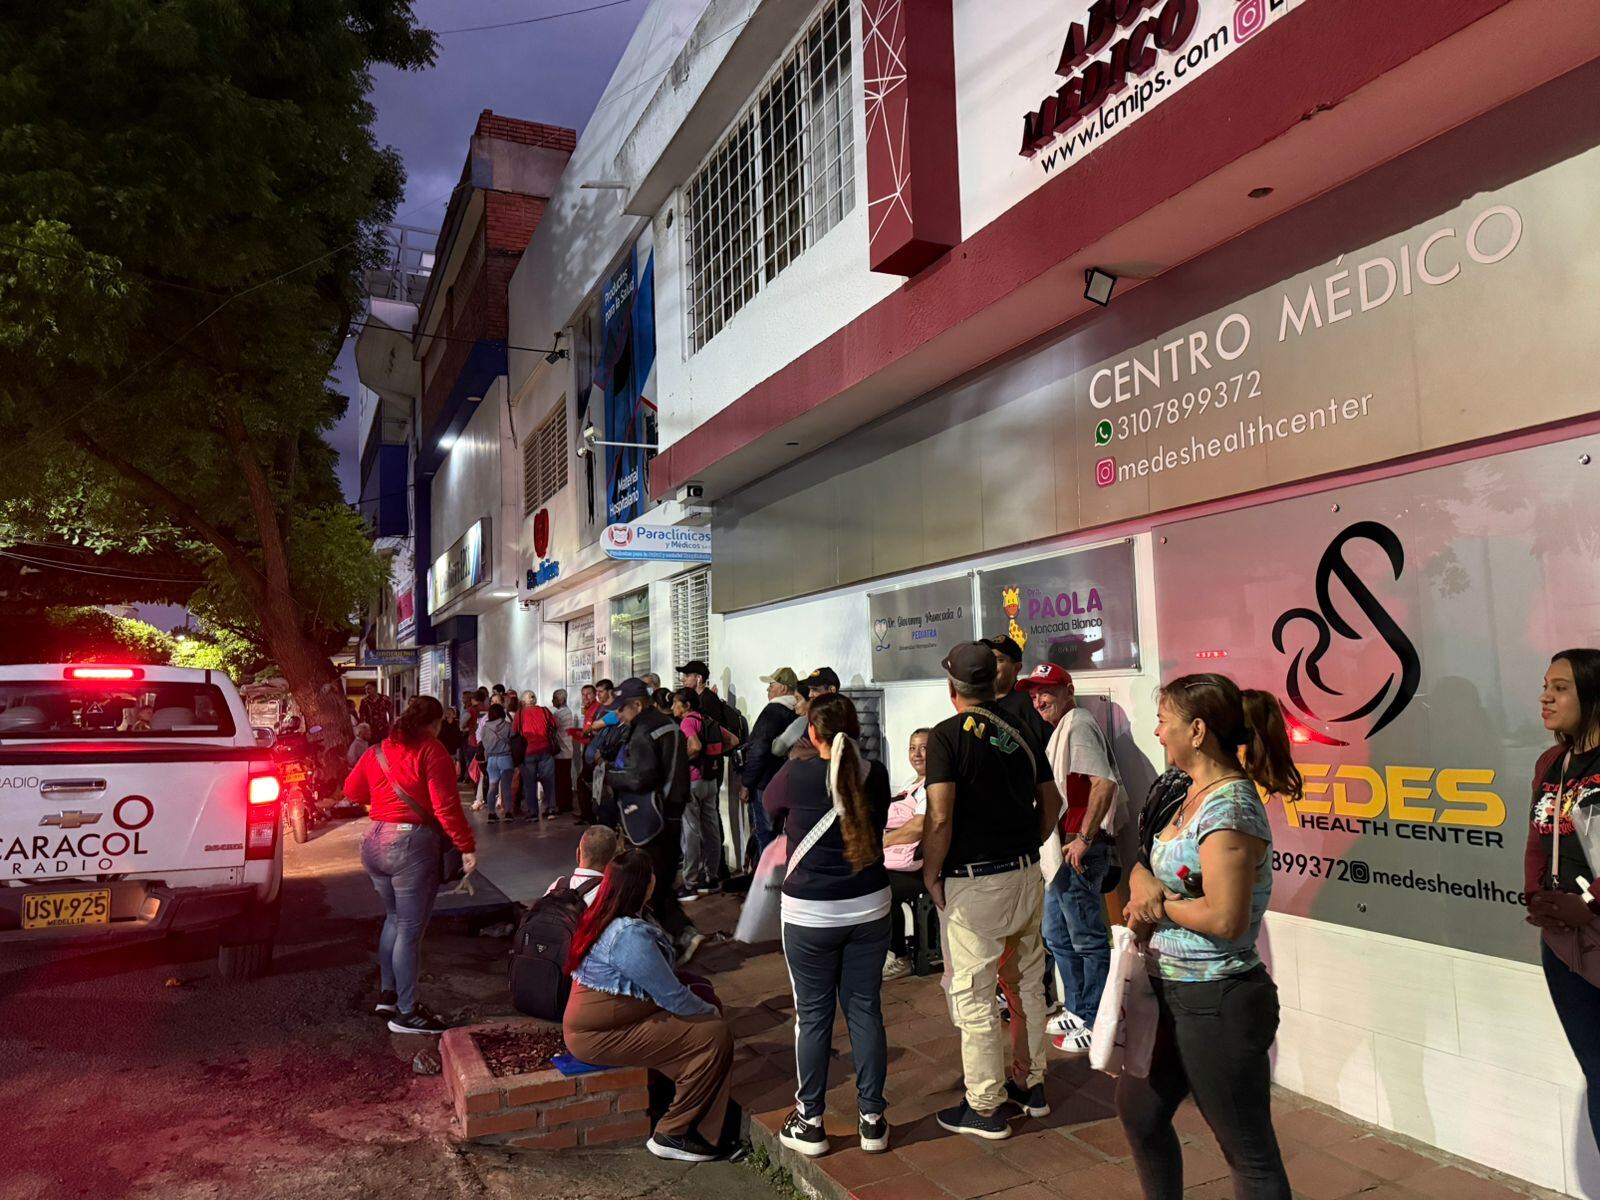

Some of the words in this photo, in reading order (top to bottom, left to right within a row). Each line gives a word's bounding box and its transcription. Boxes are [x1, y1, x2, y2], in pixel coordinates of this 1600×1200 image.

[605, 304, 616, 327] para
[620, 275, 635, 304] Salud
[1089, 312, 1251, 409] CENTRO
[1278, 205, 1523, 342] MÉDICO
[1117, 370, 1263, 440] 3107899372
[1117, 392, 1375, 481] medeshealthcenter
[617, 465, 639, 494] Material
[609, 487, 640, 518] Hospitalario
[636, 526, 711, 541] Paraclínicas
[670, 541, 700, 549] Médicos
[1028, 587, 1103, 620] PAOLA
[1030, 620, 1070, 634] Moncada
[1071, 617, 1103, 630] Blanco
[1039, 665, 1050, 673] 3
[1301, 814, 1389, 838] HEALTH
[1395, 824, 1505, 849] CENTER
[12, 857, 114, 875] RADIO
